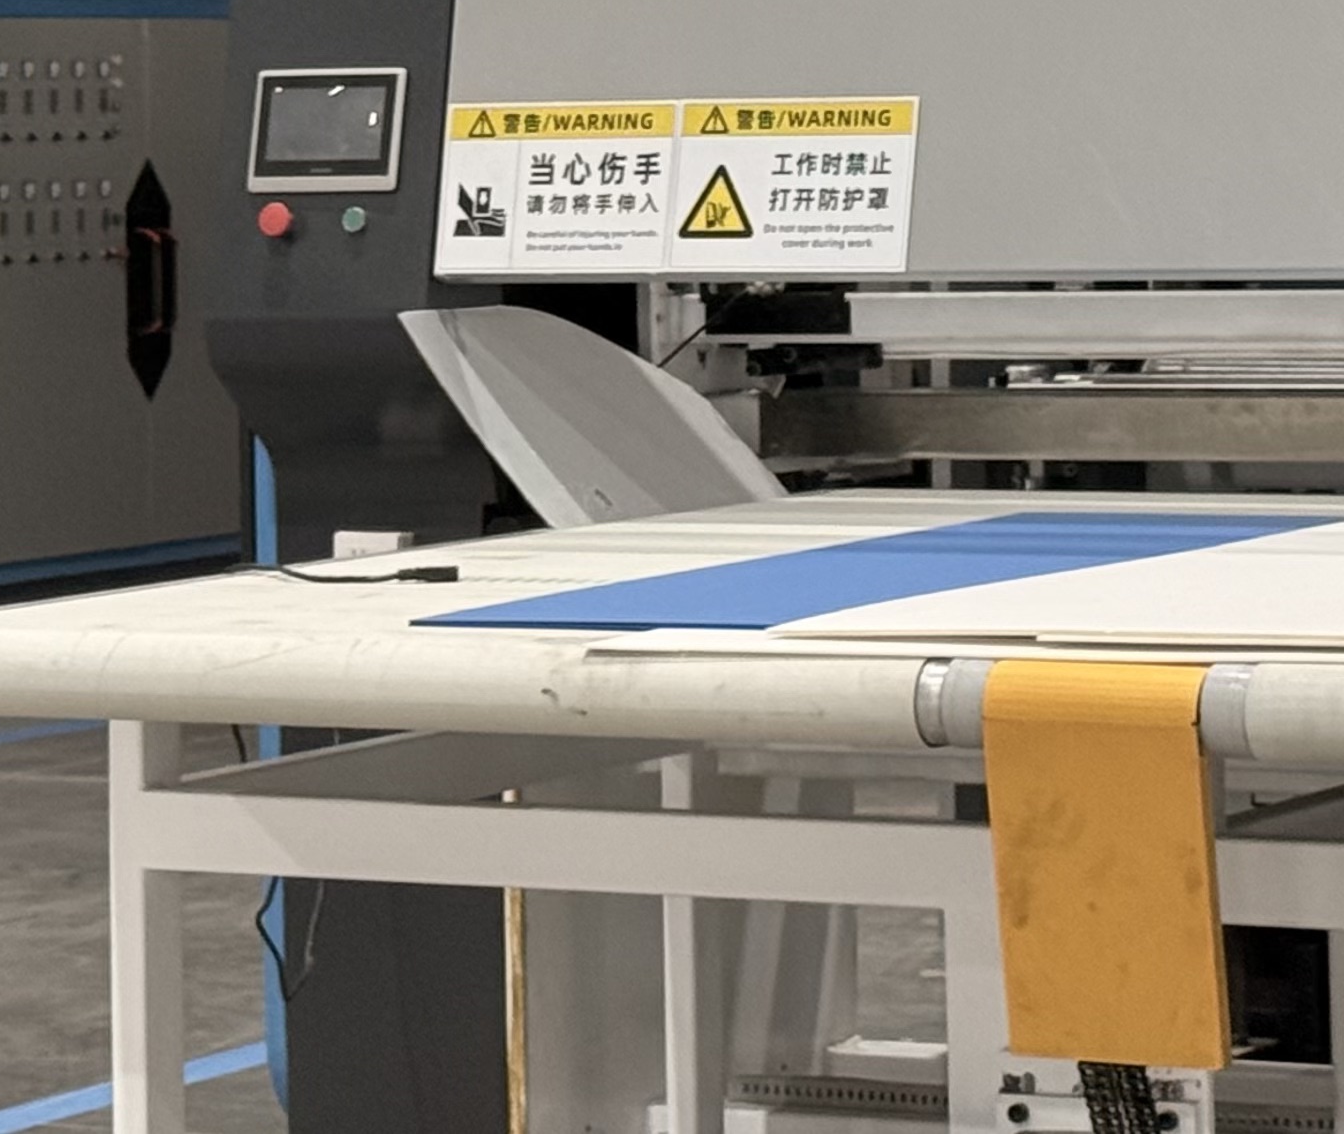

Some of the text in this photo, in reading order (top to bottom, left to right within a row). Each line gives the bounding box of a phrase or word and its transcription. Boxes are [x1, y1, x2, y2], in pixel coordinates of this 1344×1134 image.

[528, 152, 662, 186] 当心伤手
[770, 151, 892, 176] 工作时禁止
[526, 193, 659, 215] 请勿将手伸入
[768, 187, 890, 212] 打开防护罩
